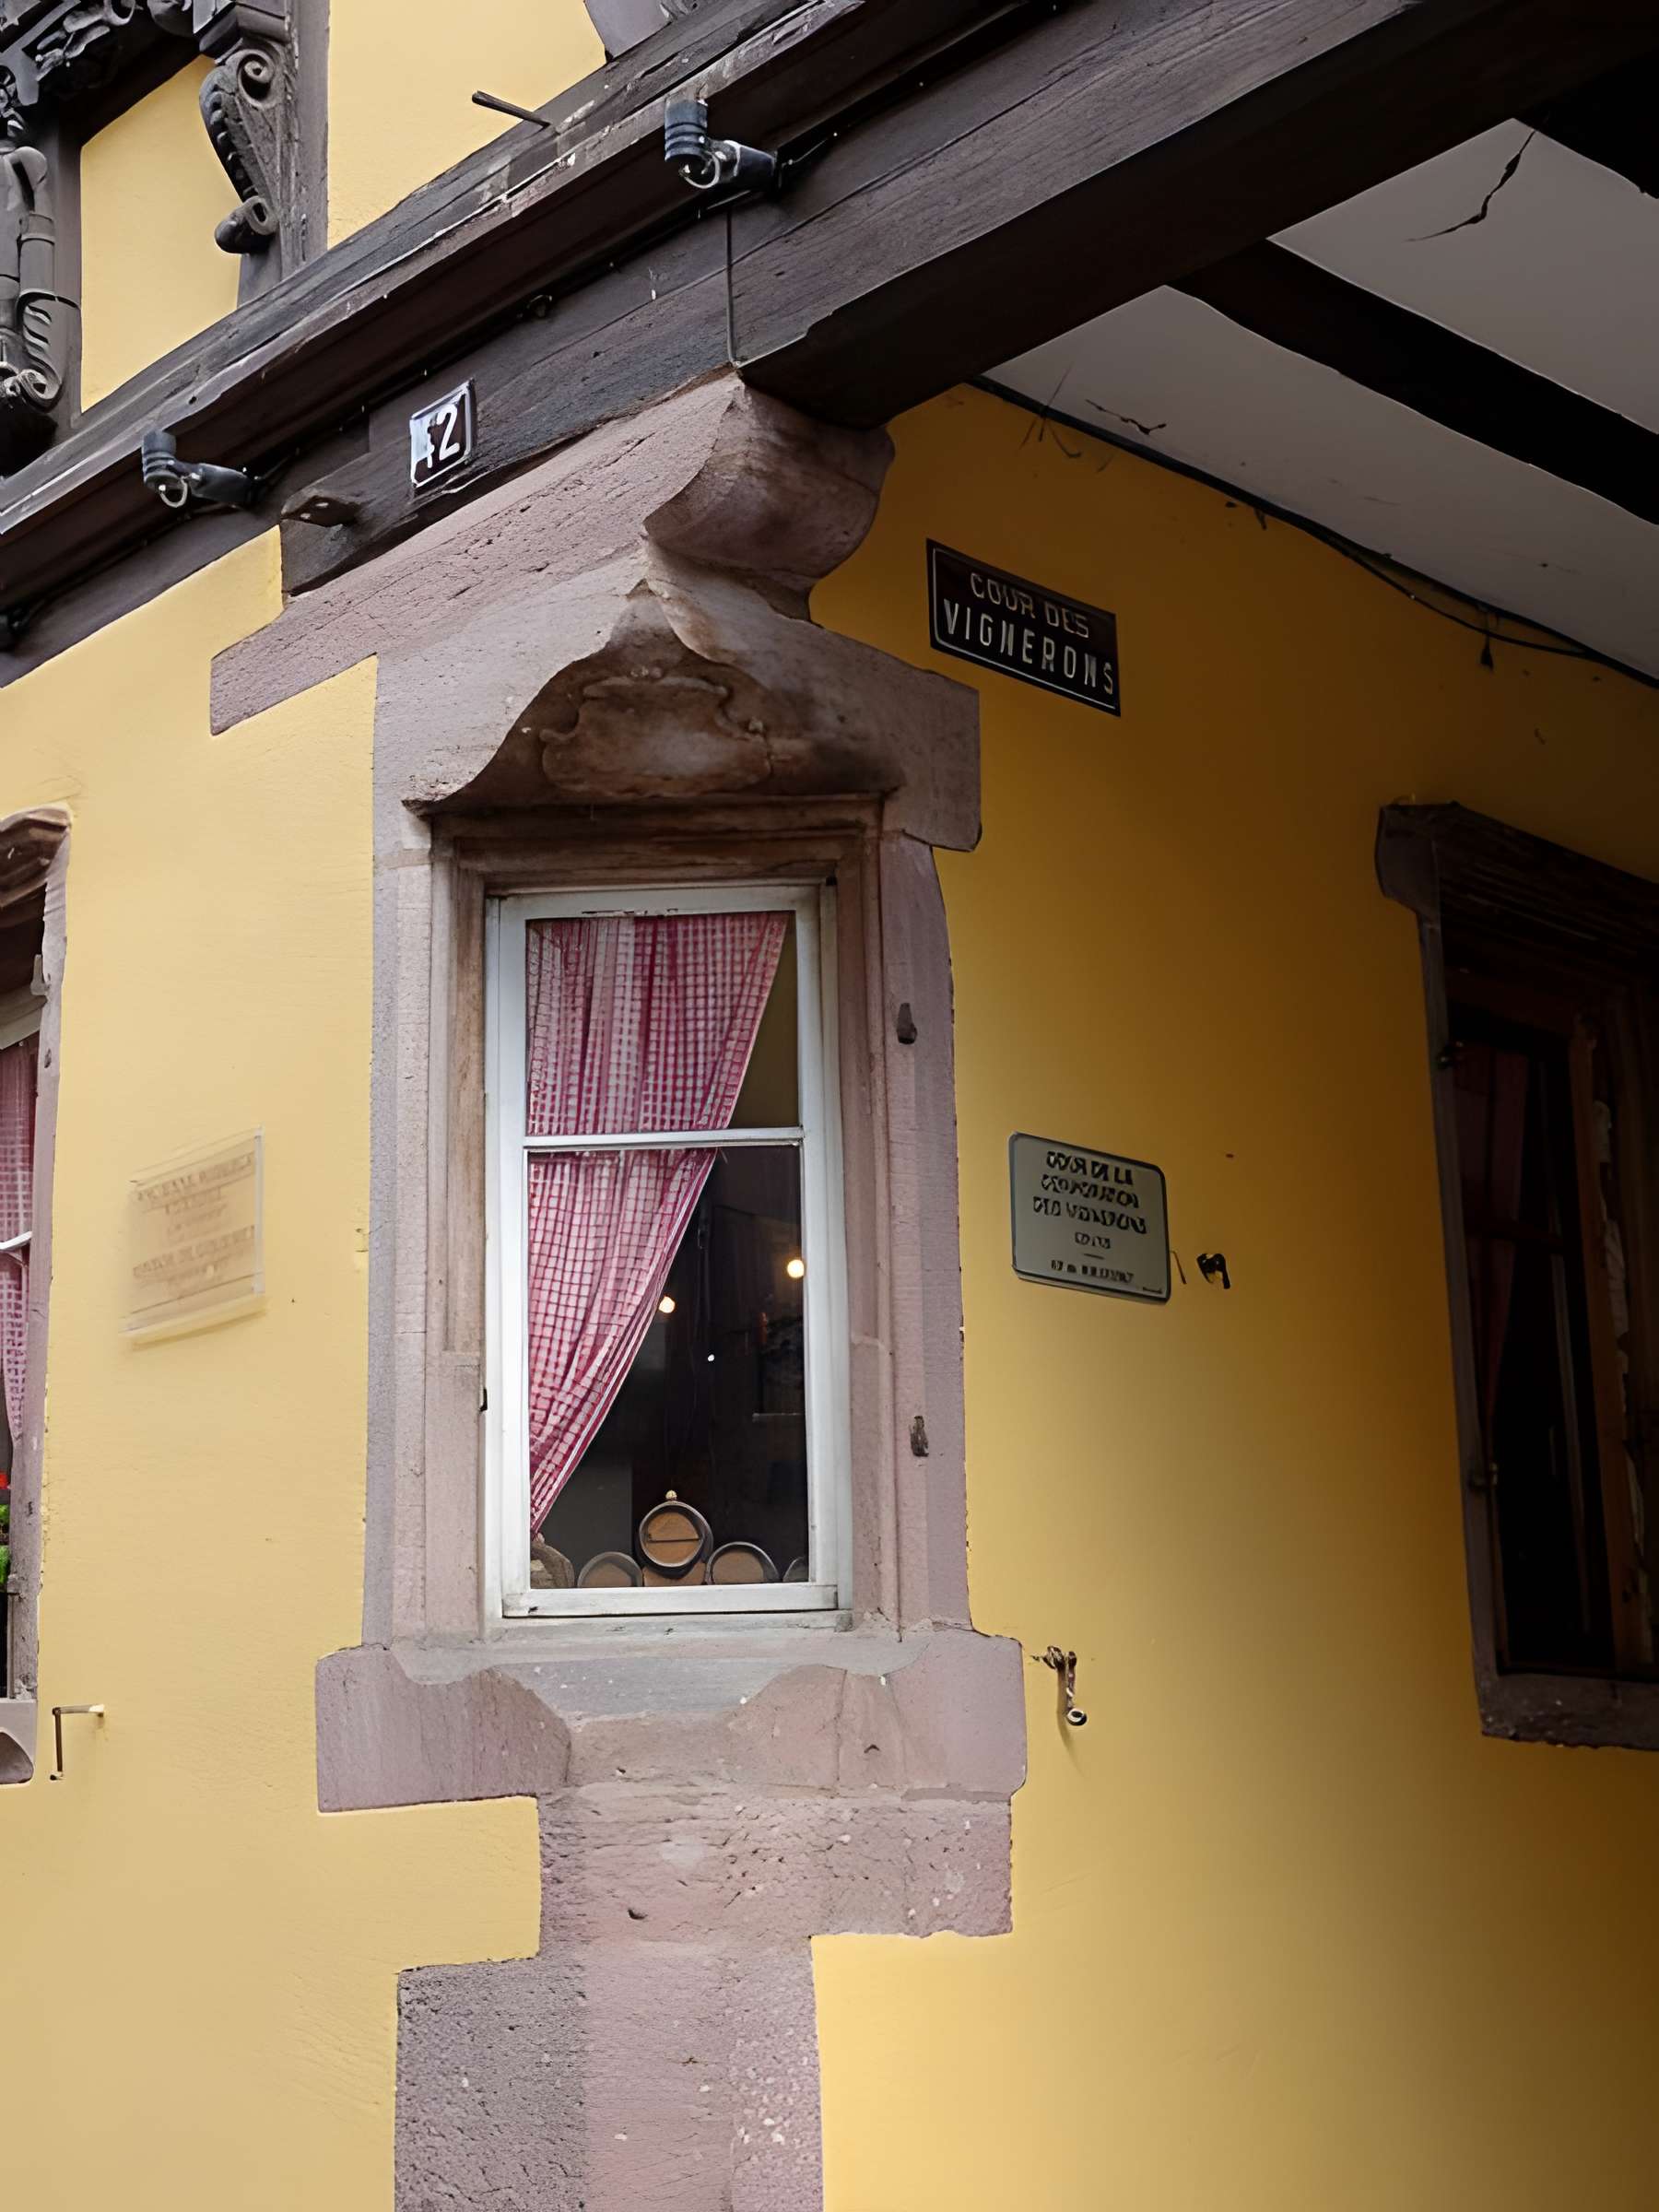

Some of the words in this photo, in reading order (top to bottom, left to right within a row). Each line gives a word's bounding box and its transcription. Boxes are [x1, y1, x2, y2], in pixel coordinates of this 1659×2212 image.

[971, 571, 1036, 618] COUR
[1044, 600, 1089, 639] DES
[943, 598, 1114, 695] VIGNERONS
